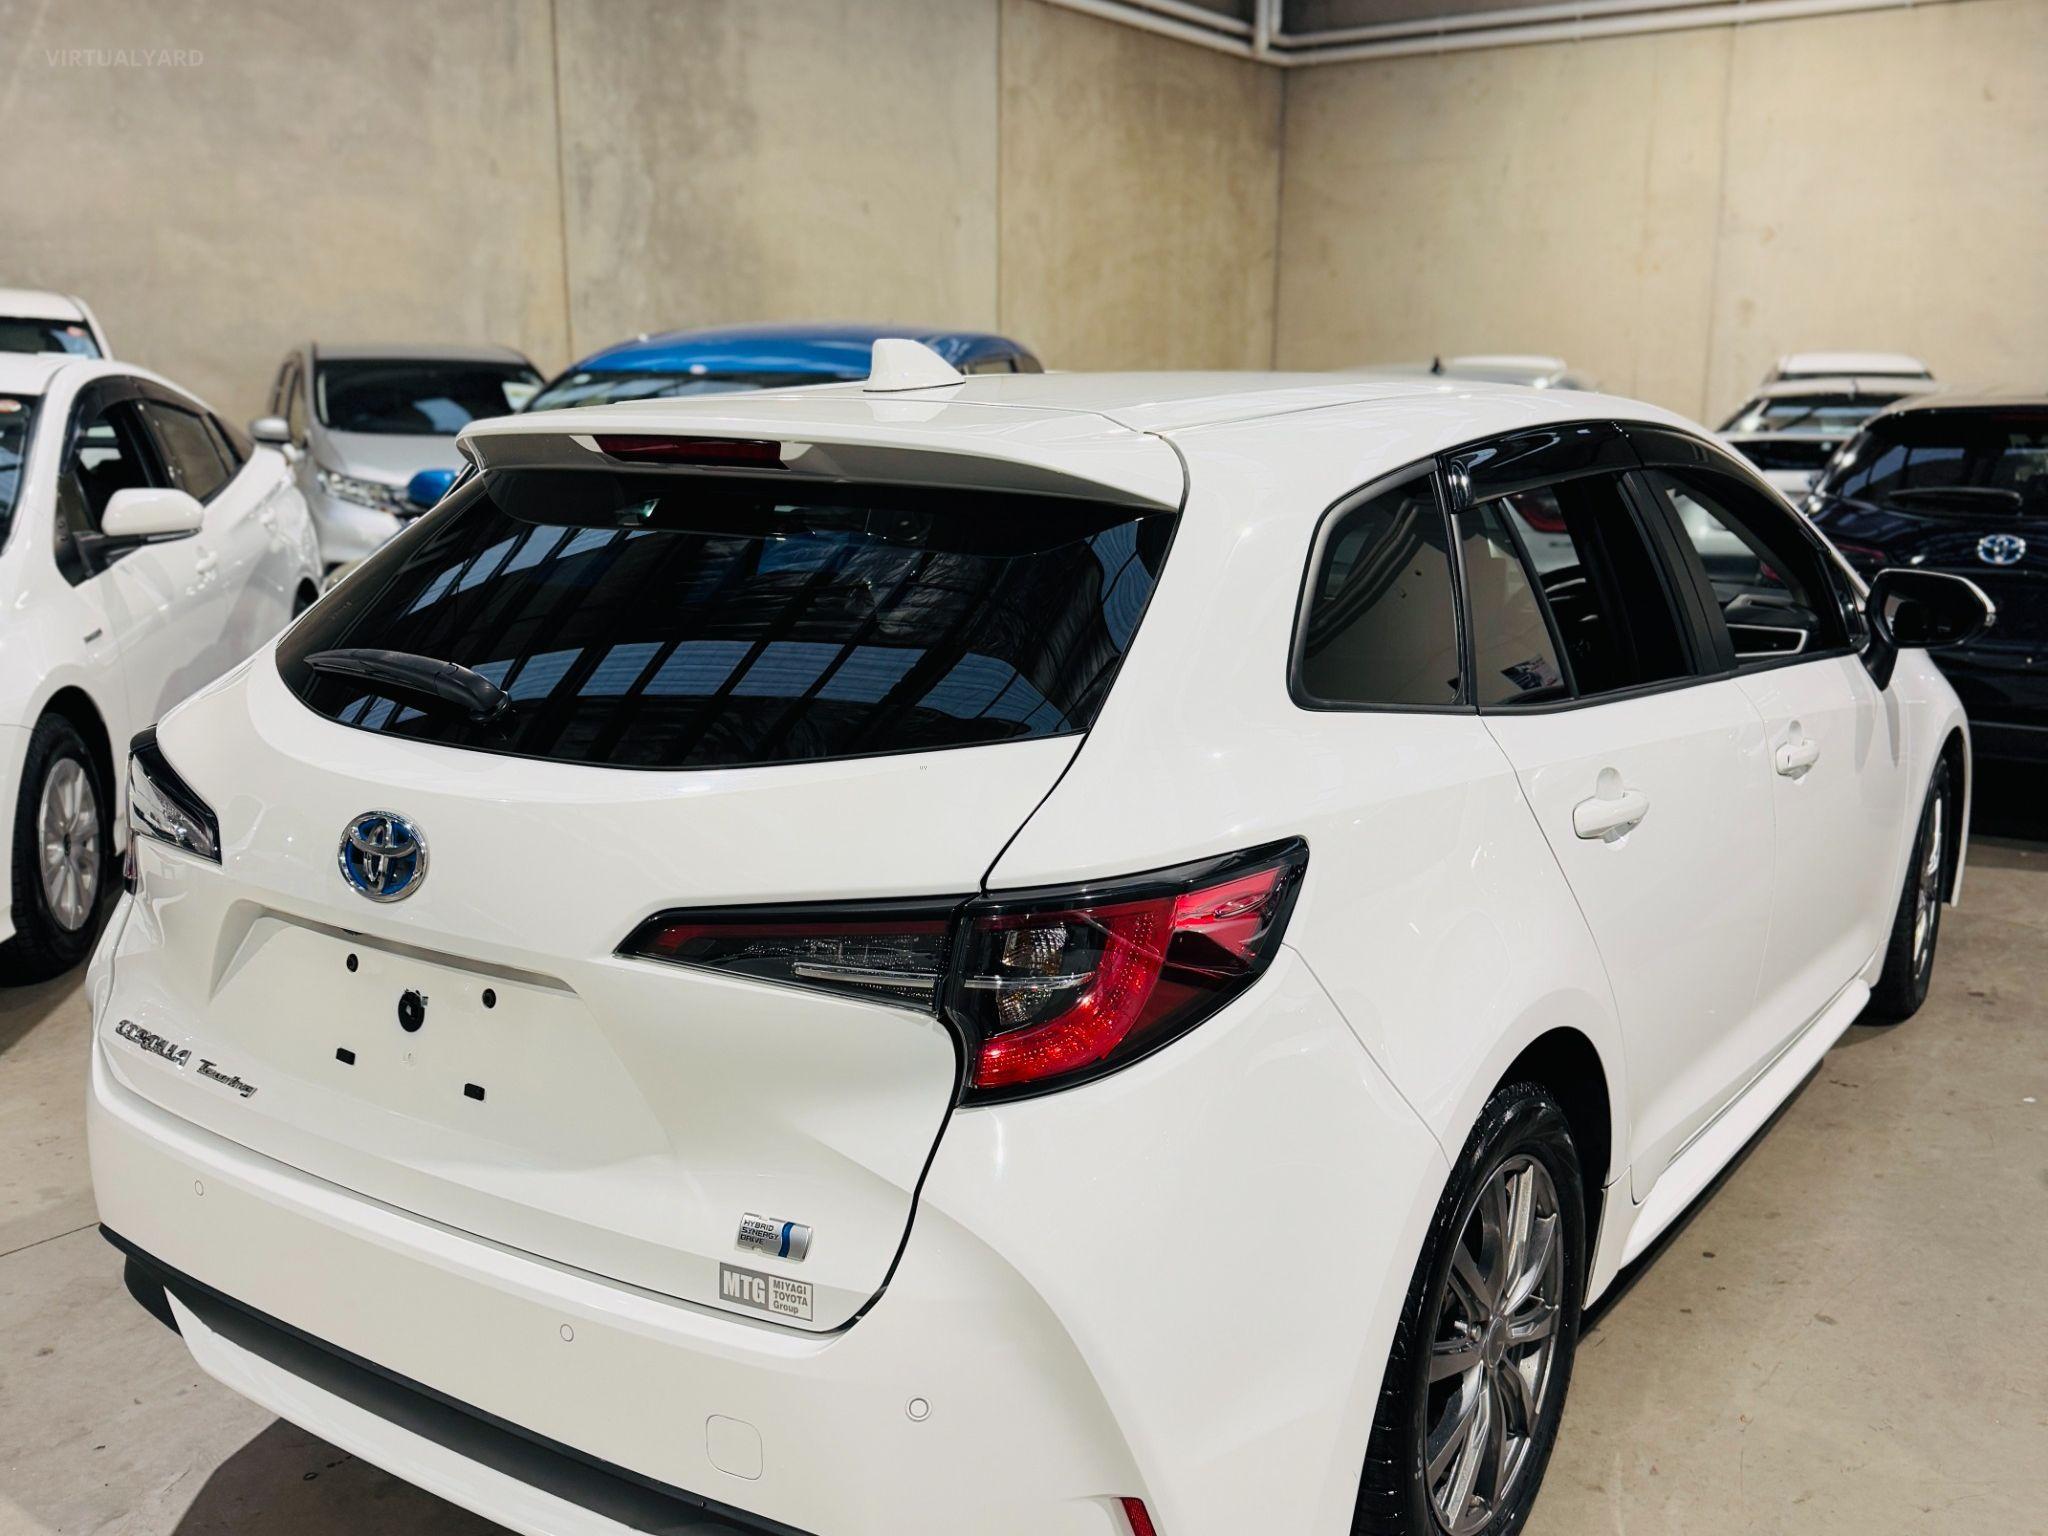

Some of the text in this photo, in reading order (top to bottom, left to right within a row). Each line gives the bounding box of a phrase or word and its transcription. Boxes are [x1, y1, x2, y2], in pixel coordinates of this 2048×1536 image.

[196, 1058, 258, 1098] Touring
[741, 1226, 779, 1240] SYNERGY
[744, 1219, 774, 1232] HYBRID
[740, 1233, 765, 1245] DRIVE
[723, 1269, 766, 1305] MTG
[773, 1279, 807, 1295] MIYAGI
[773, 1290, 808, 1307] TOYOTA
[773, 1300, 799, 1314] Group
